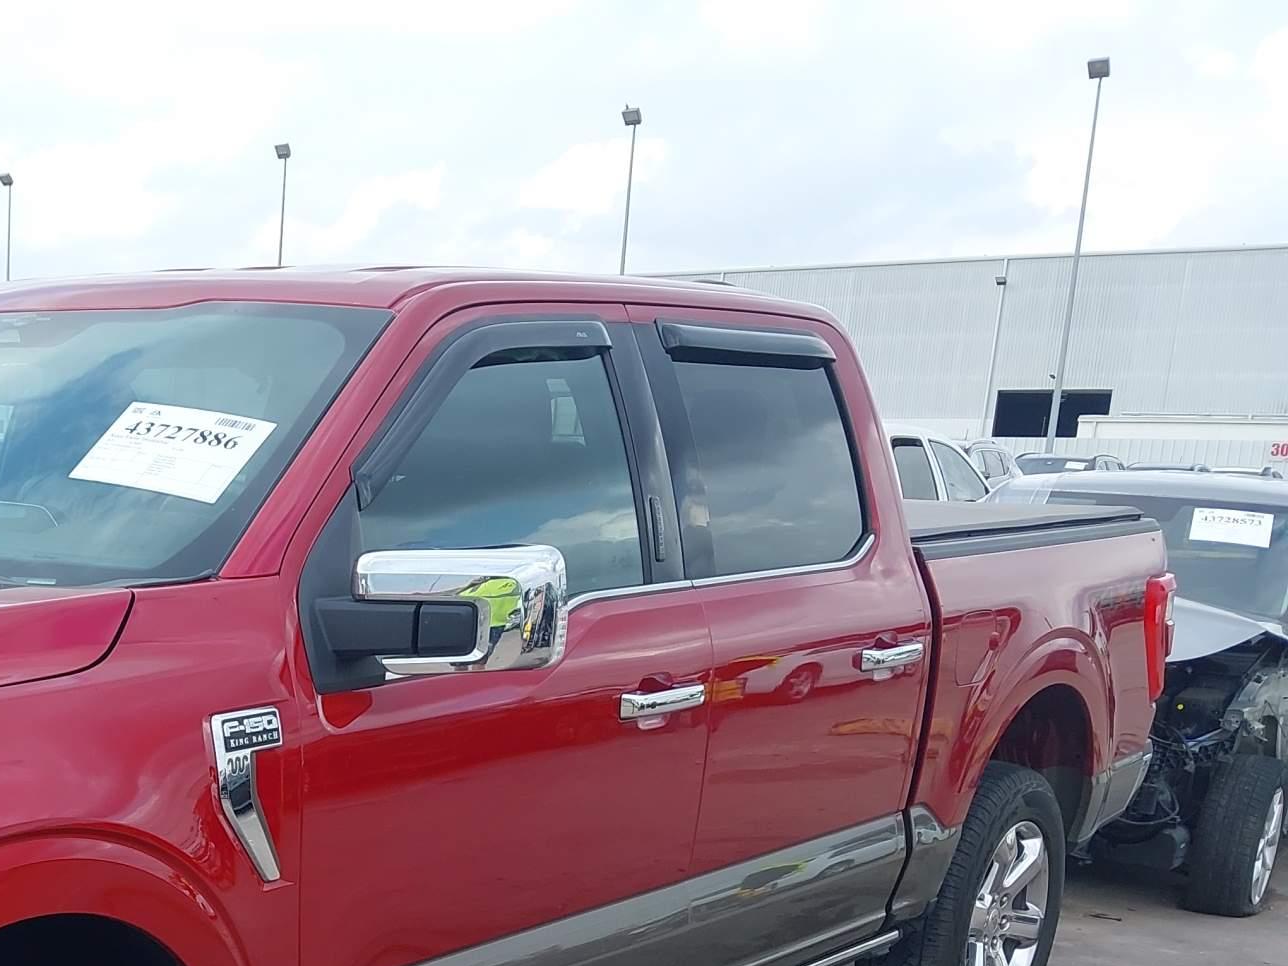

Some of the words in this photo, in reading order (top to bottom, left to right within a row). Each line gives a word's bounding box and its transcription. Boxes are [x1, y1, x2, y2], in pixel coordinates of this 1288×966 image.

[125, 419, 245, 450] 43727886
[1200, 515, 1262, 527] 43728573
[223, 714, 279, 738] F-150
[230, 739, 250, 748] KING
[252, 732, 279, 746] RANCH
